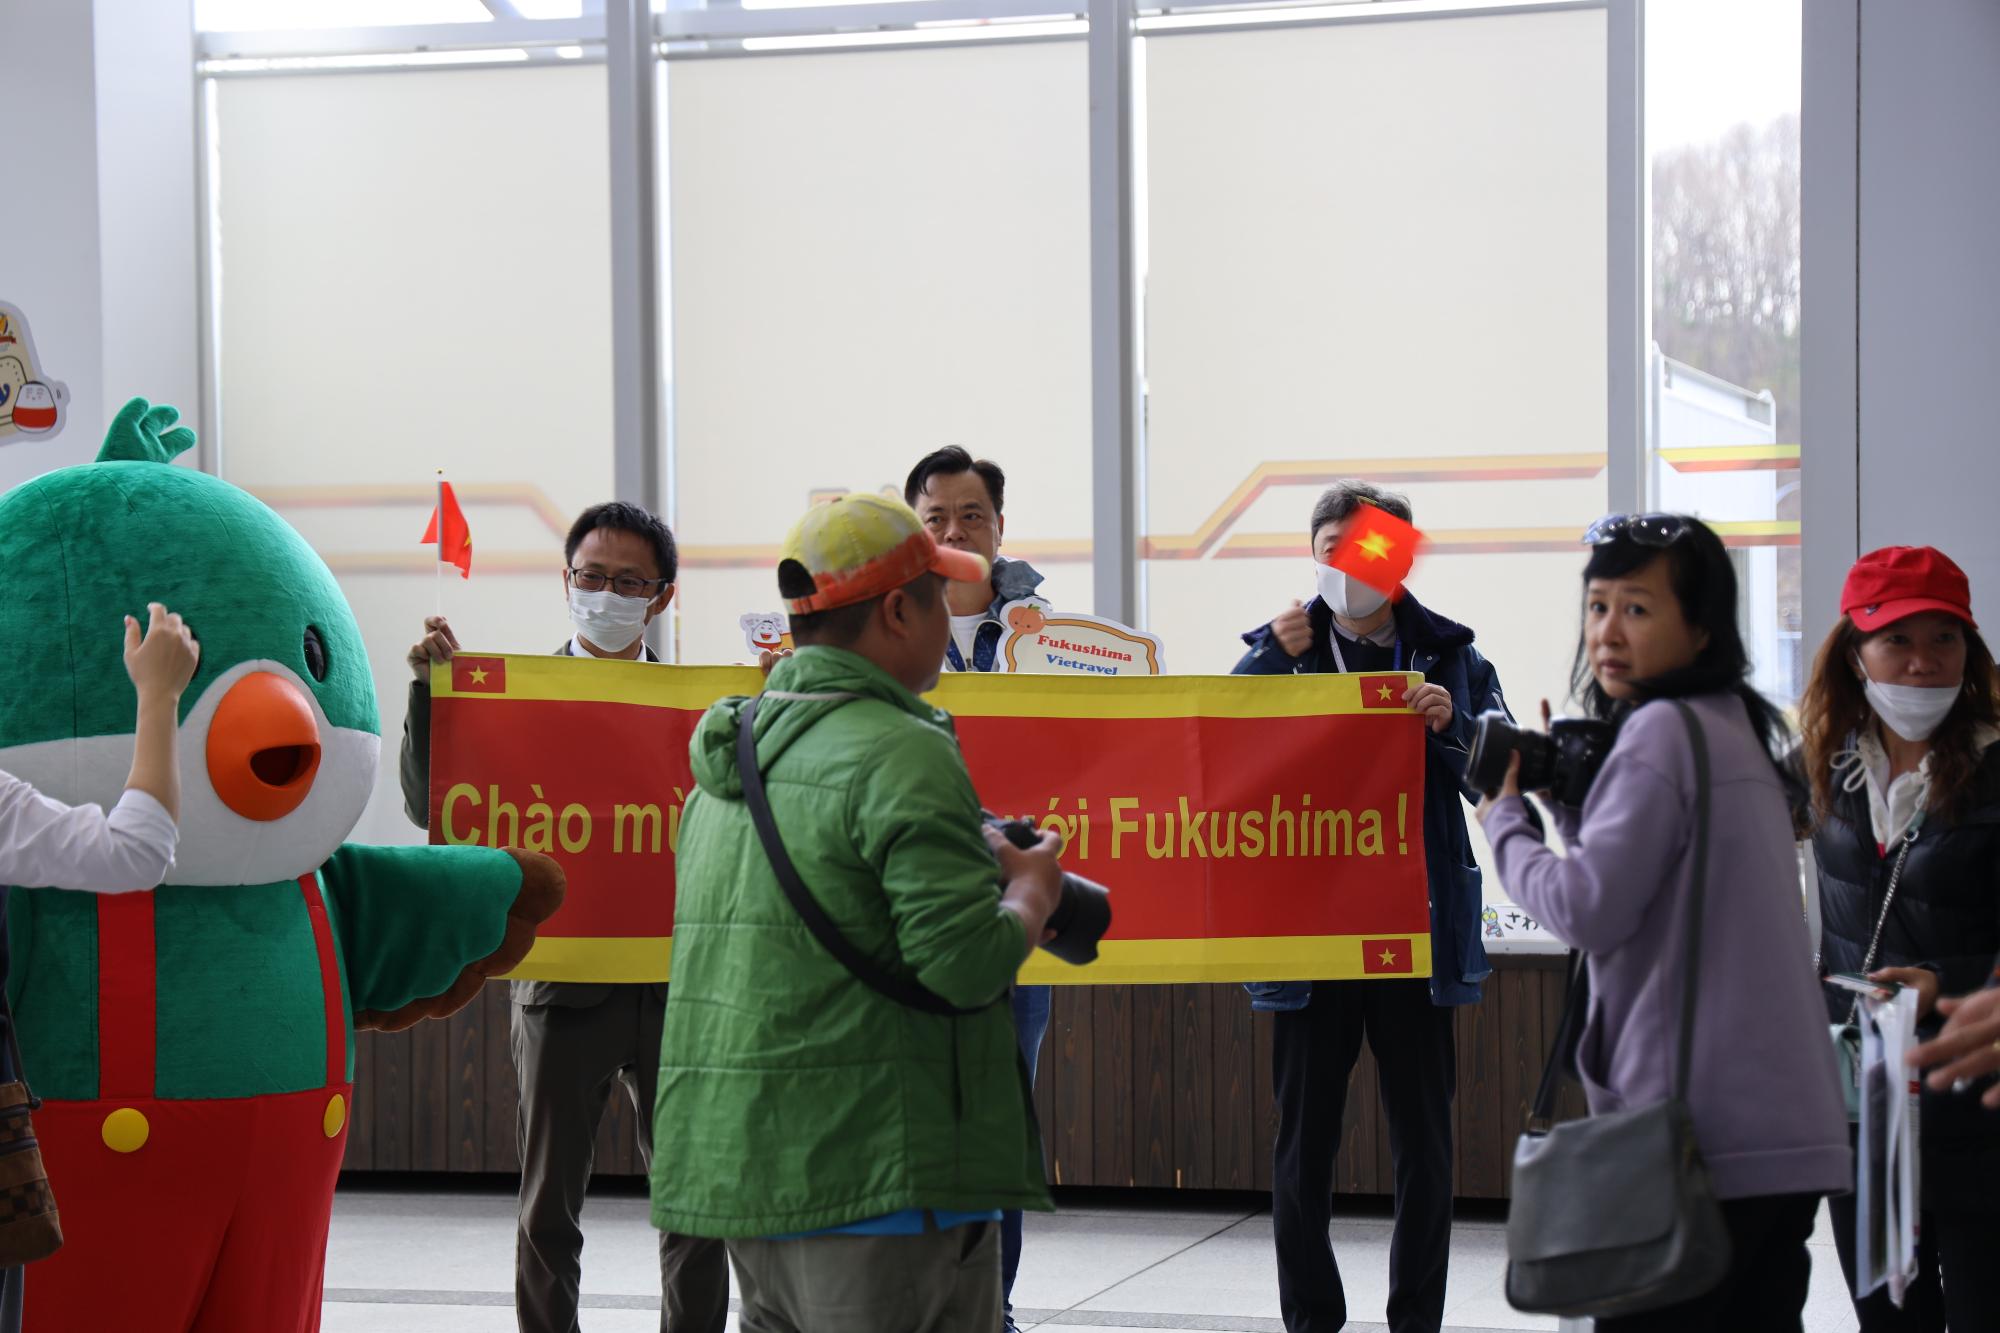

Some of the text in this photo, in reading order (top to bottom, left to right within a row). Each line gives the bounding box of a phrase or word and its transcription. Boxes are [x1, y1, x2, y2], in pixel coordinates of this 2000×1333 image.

[1037, 634, 1132, 662] Fukushima
[1046, 653, 1118, 676] Vietravel
[441, 783, 594, 854] Chào
[1005, 797, 1090, 860] ới
